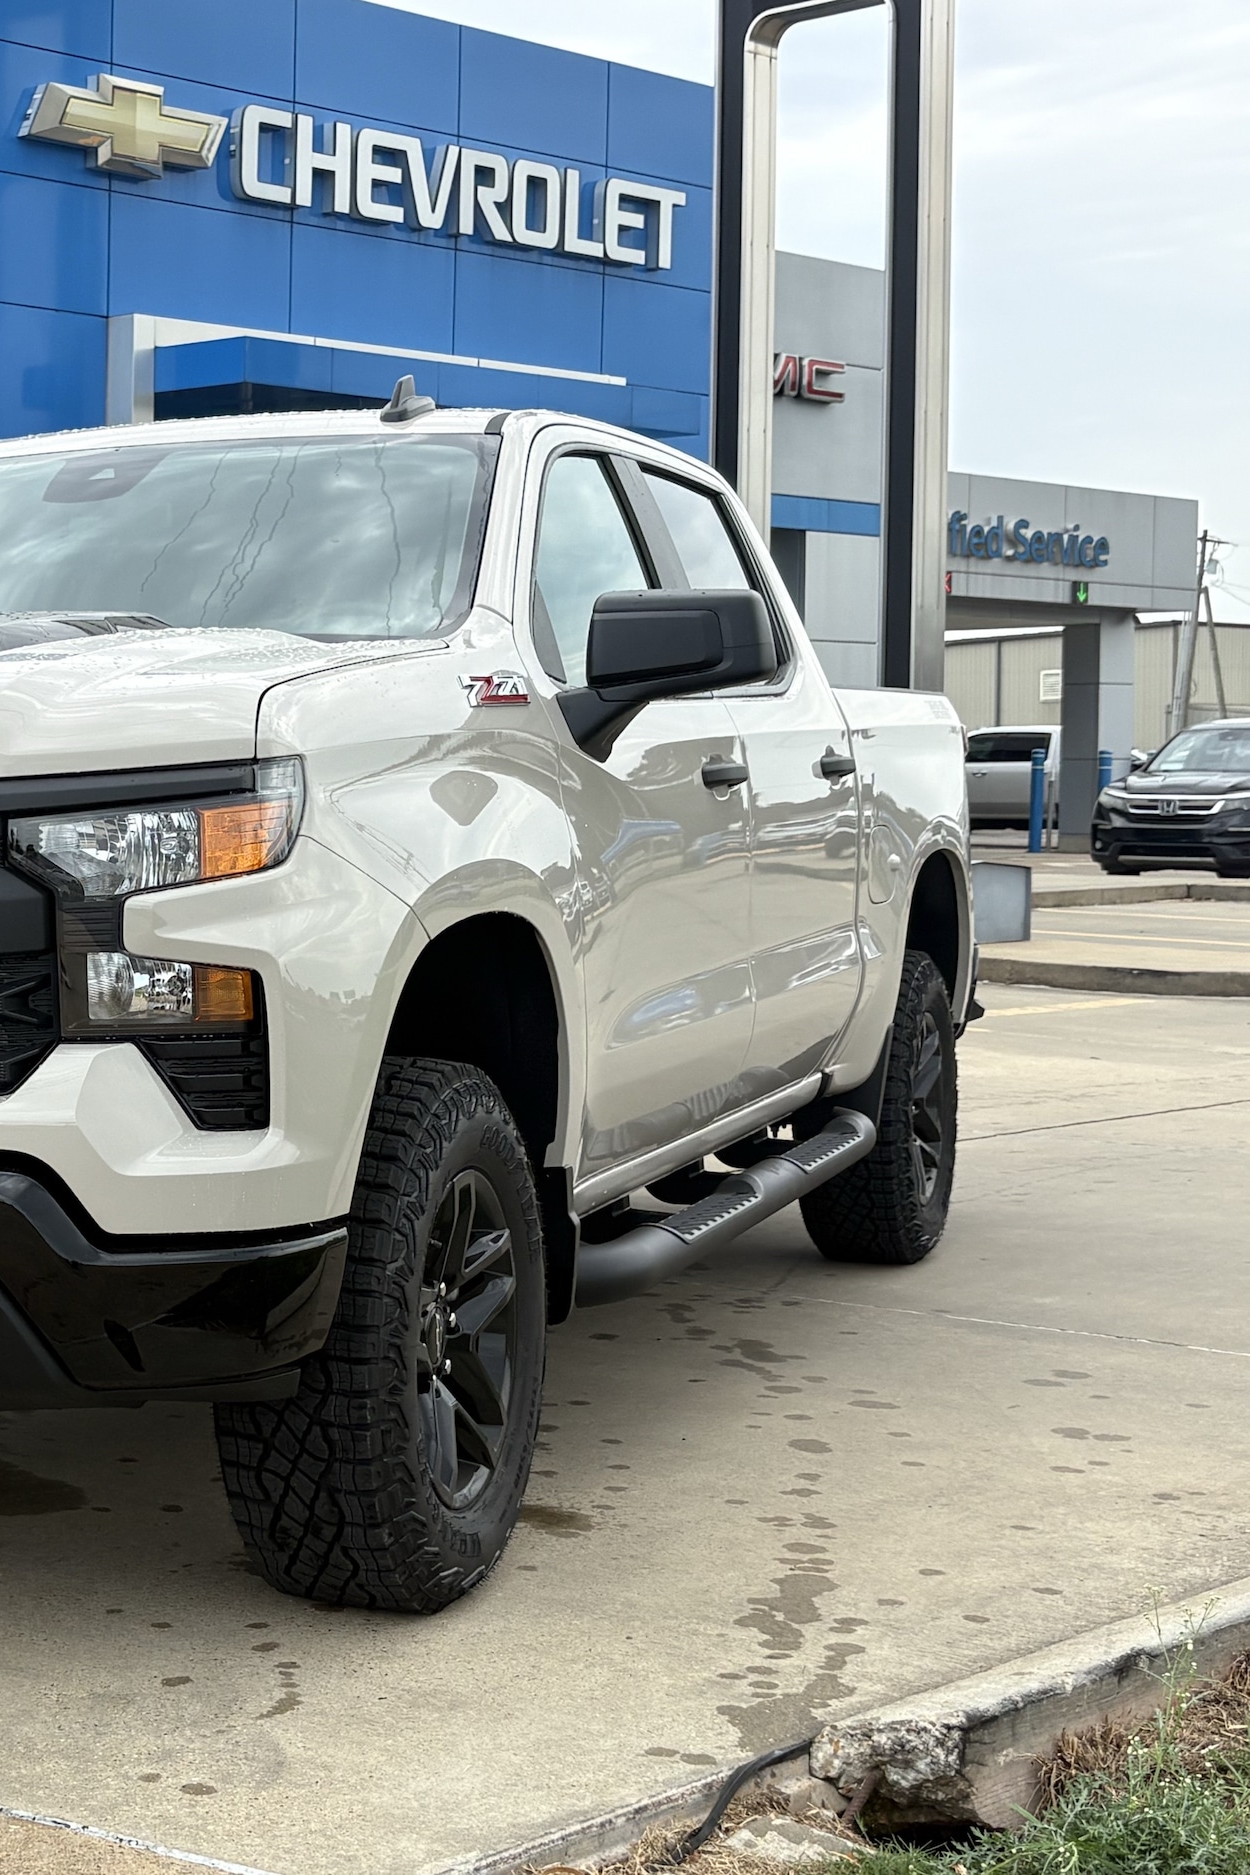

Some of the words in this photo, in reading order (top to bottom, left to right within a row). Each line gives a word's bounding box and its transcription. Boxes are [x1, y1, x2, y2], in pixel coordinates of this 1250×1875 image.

[232, 104, 687, 271] CHEVROLET
[772, 353, 846, 402] MC
[947, 510, 1004, 558] fied
[1012, 518, 1110, 568] Service
